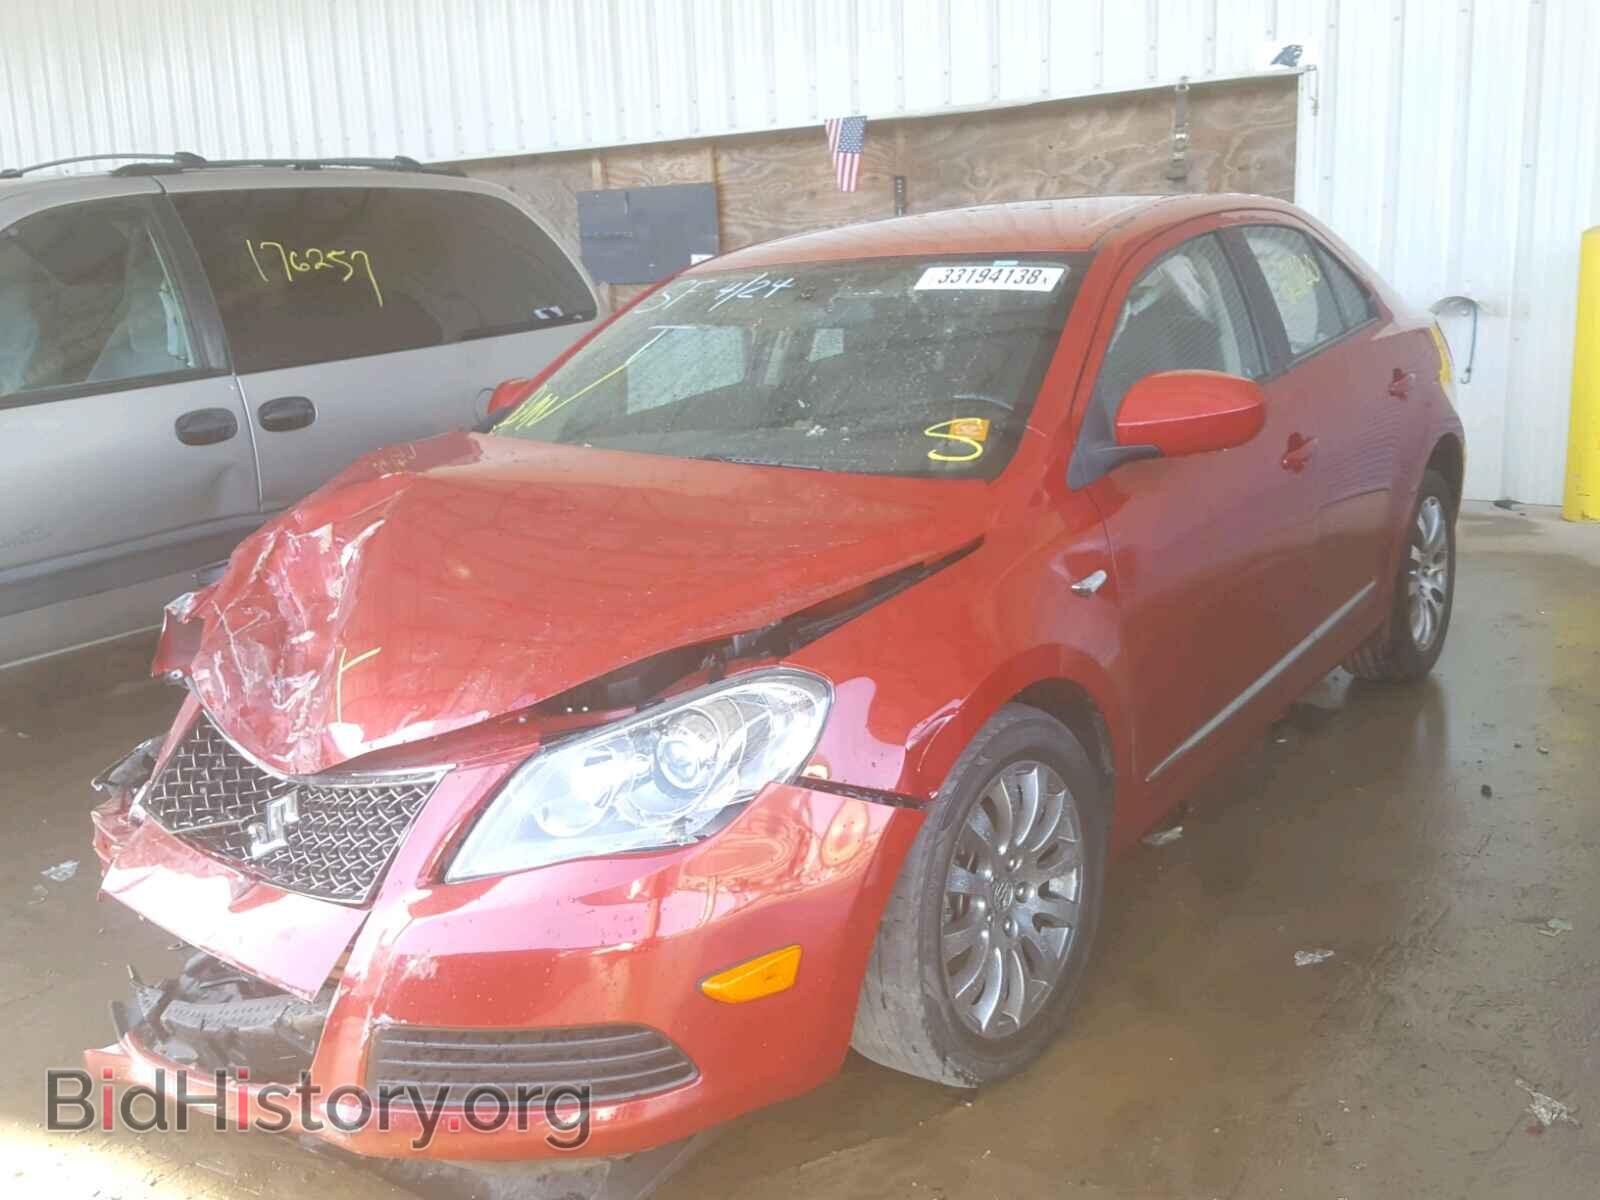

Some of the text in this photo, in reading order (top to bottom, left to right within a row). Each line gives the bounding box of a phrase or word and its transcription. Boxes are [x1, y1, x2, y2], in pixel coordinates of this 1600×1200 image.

[246, 239, 384, 307] 176257
[708, 272, 795, 312] 4/24
[938, 268, 1042, 285] 33194138
